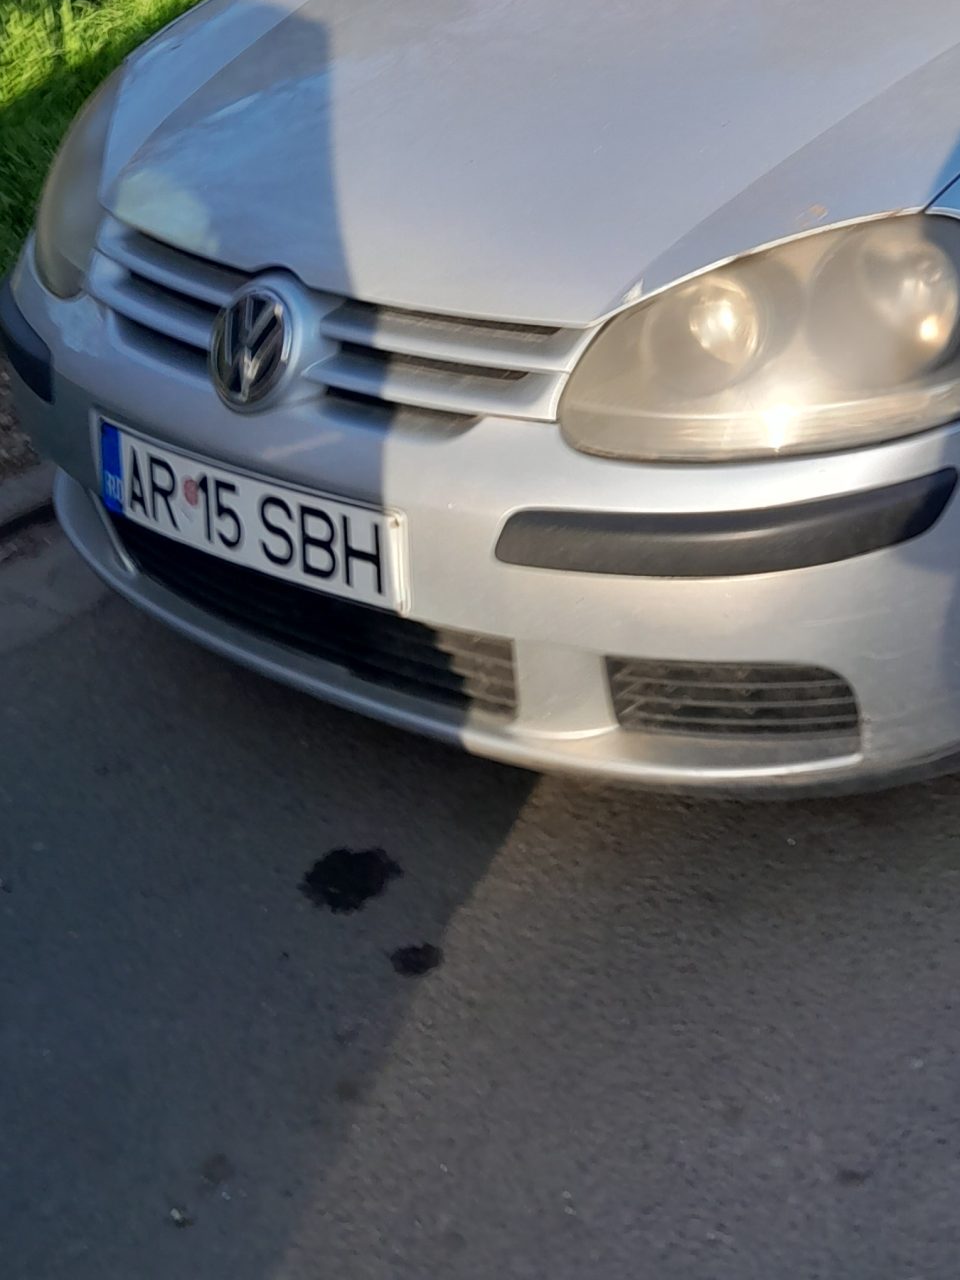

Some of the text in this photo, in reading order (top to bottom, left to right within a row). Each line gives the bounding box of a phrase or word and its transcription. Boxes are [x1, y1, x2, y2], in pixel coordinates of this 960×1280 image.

[128, 444, 383, 595] AR 15 SBH
